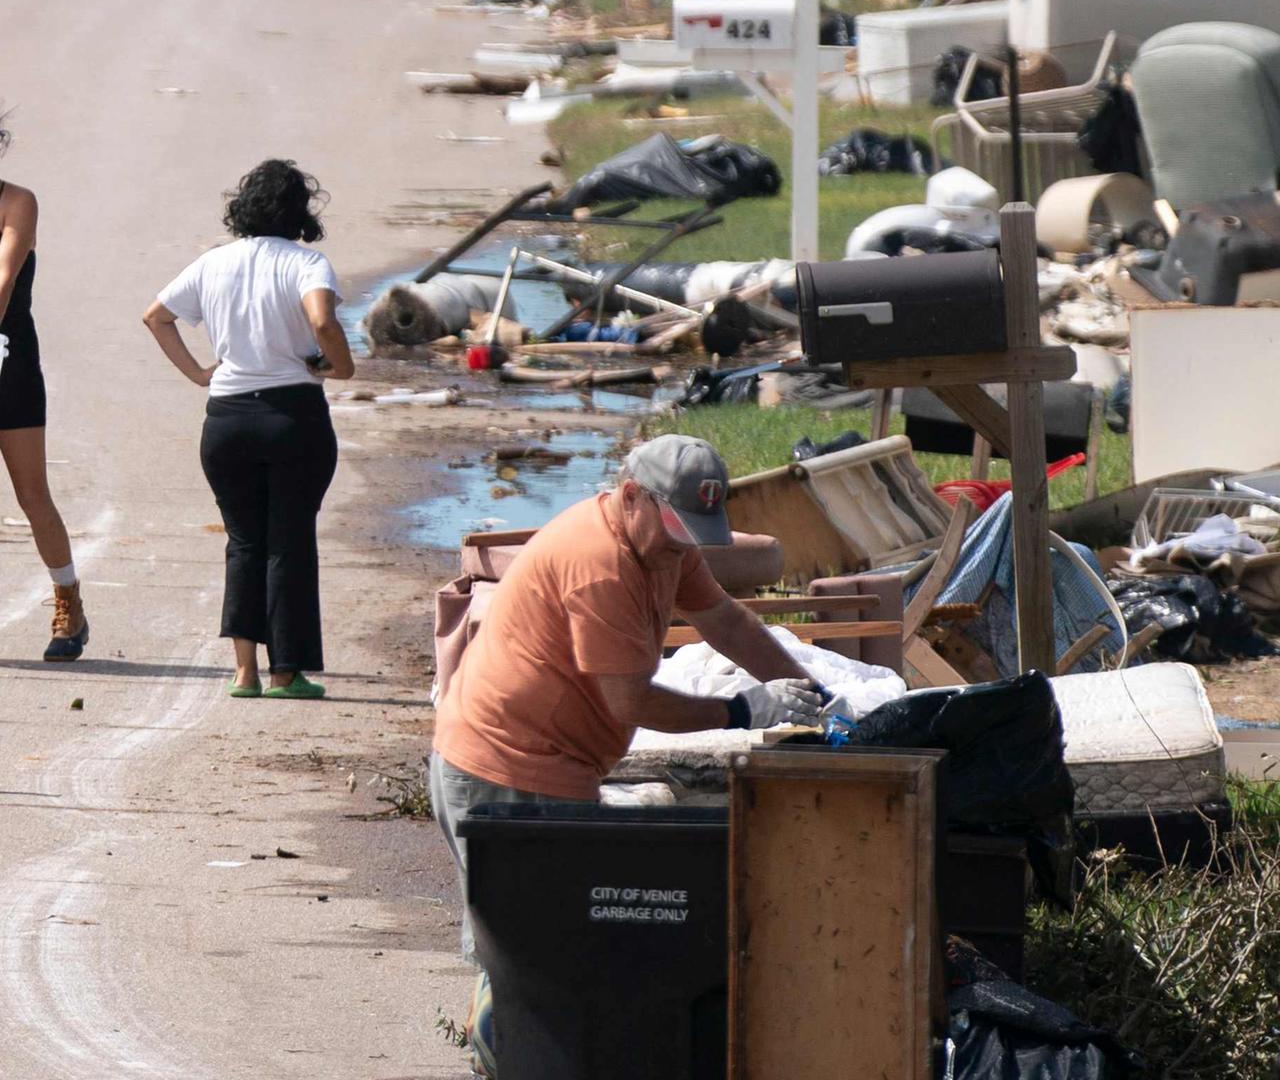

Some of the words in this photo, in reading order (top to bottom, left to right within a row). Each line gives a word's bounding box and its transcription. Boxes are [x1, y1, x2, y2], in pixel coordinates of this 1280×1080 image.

[726, 19, 771, 38] 424
[591, 887, 620, 900] CITY
[622, 888, 640, 900] OF
[642, 889, 688, 902] VENICE
[591, 906, 652, 920] GARBAGE
[654, 908, 689, 921] ONLY
